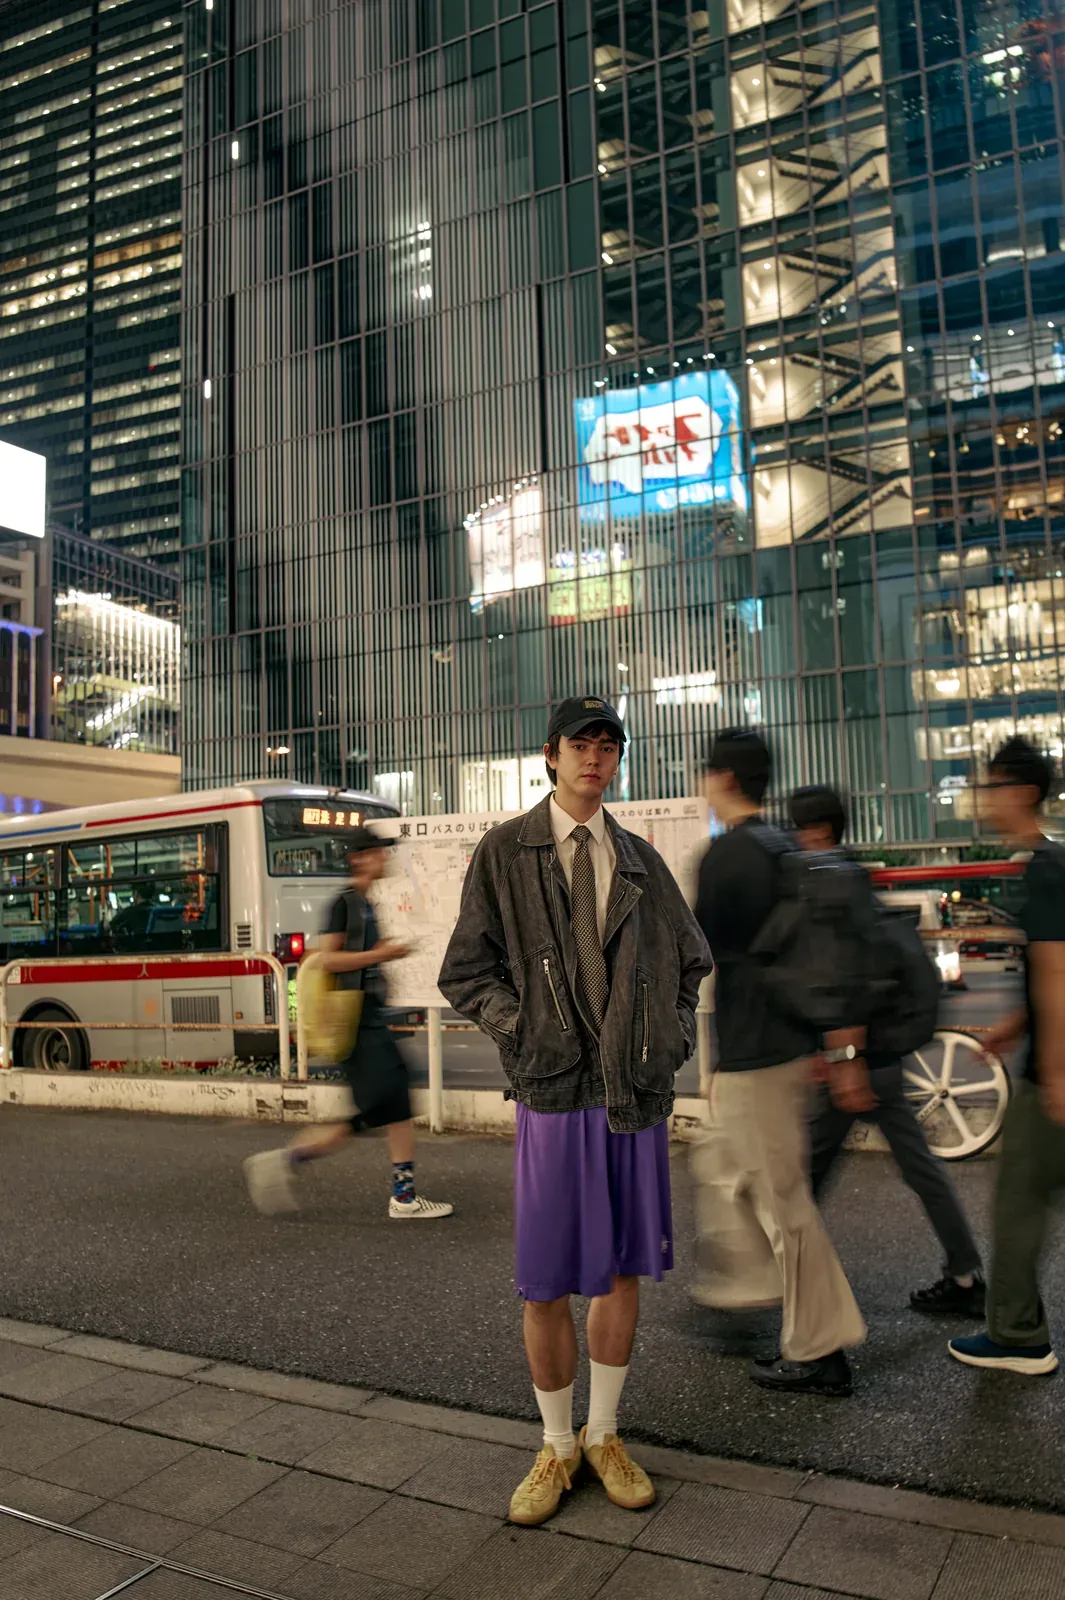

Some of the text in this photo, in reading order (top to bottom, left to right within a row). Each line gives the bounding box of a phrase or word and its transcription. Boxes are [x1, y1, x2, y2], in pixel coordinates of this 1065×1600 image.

[612, 807, 671, 817] バスのりば案内
[399, 823, 428, 838] 東口
